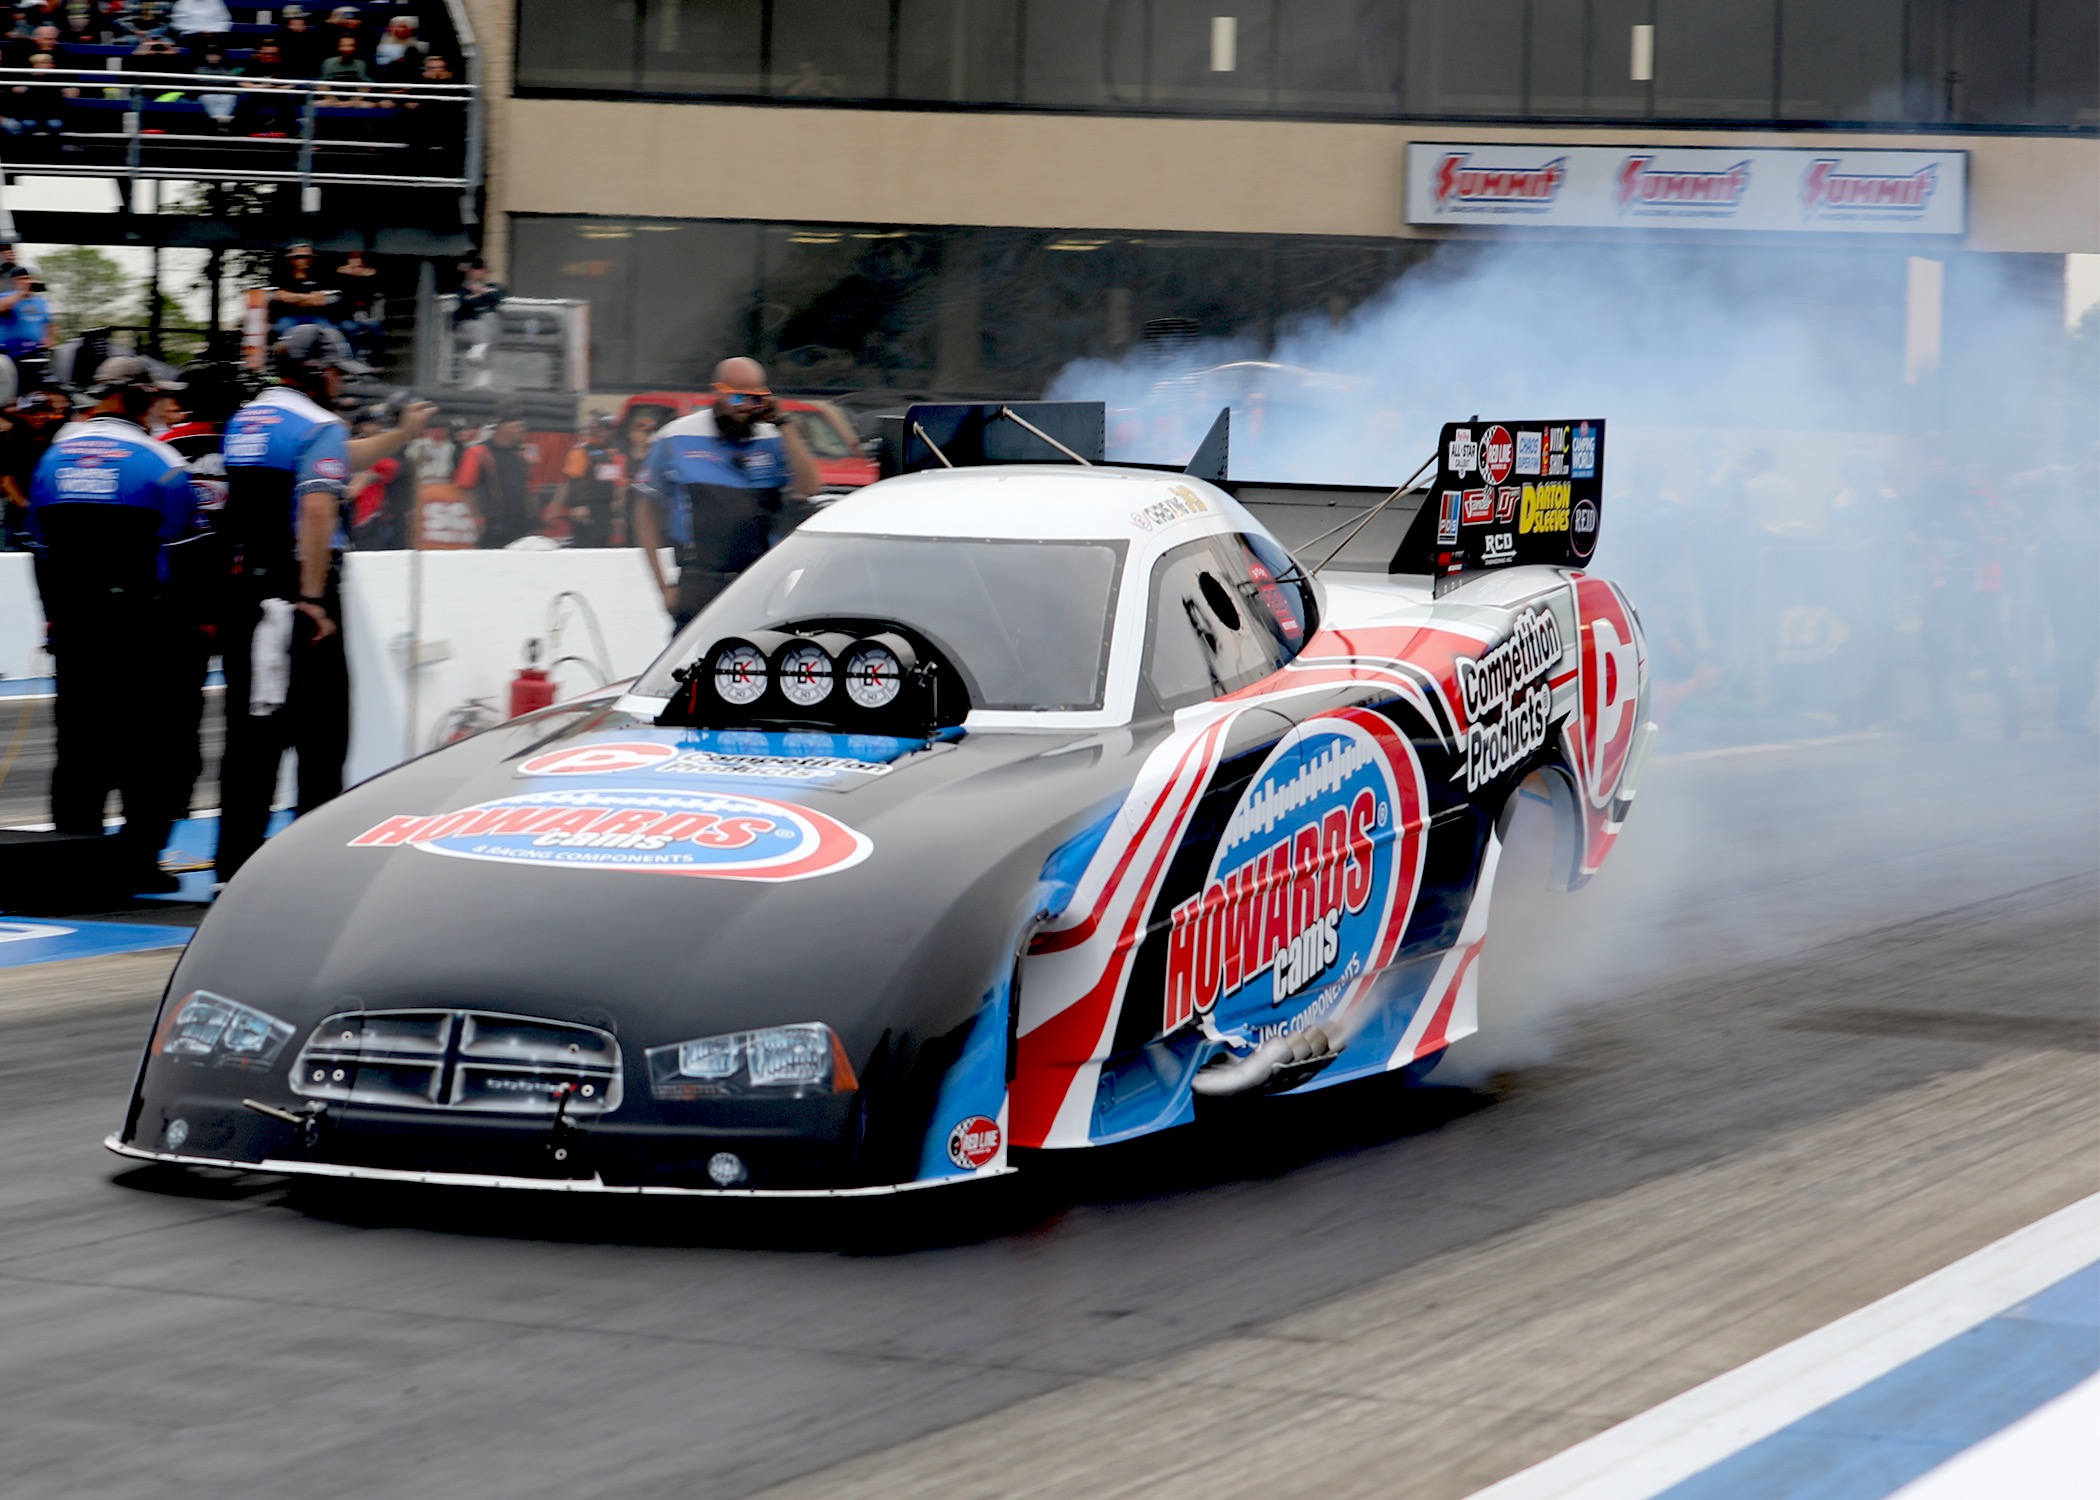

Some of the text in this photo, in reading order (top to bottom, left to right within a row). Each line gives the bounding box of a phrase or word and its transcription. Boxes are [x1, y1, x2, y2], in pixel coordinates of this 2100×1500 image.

[1519, 481, 1571, 534] DARTON
[1533, 509, 1570, 533] SLEEVES
[1575, 508, 1596, 533] REID
[1485, 533, 1513, 554] RCD
[1460, 609, 1561, 720] Competition
[1468, 687, 1546, 790] Products
[678, 752, 893, 775] Competition
[347, 807, 777, 848] HOWARDS
[533, 828, 673, 849] cams
[486, 846, 553, 860] RACING
[555, 852, 695, 863] COMPONENTS
[1163, 788, 1377, 1037] HOWARDS
[1273, 907, 1339, 1004] cams
